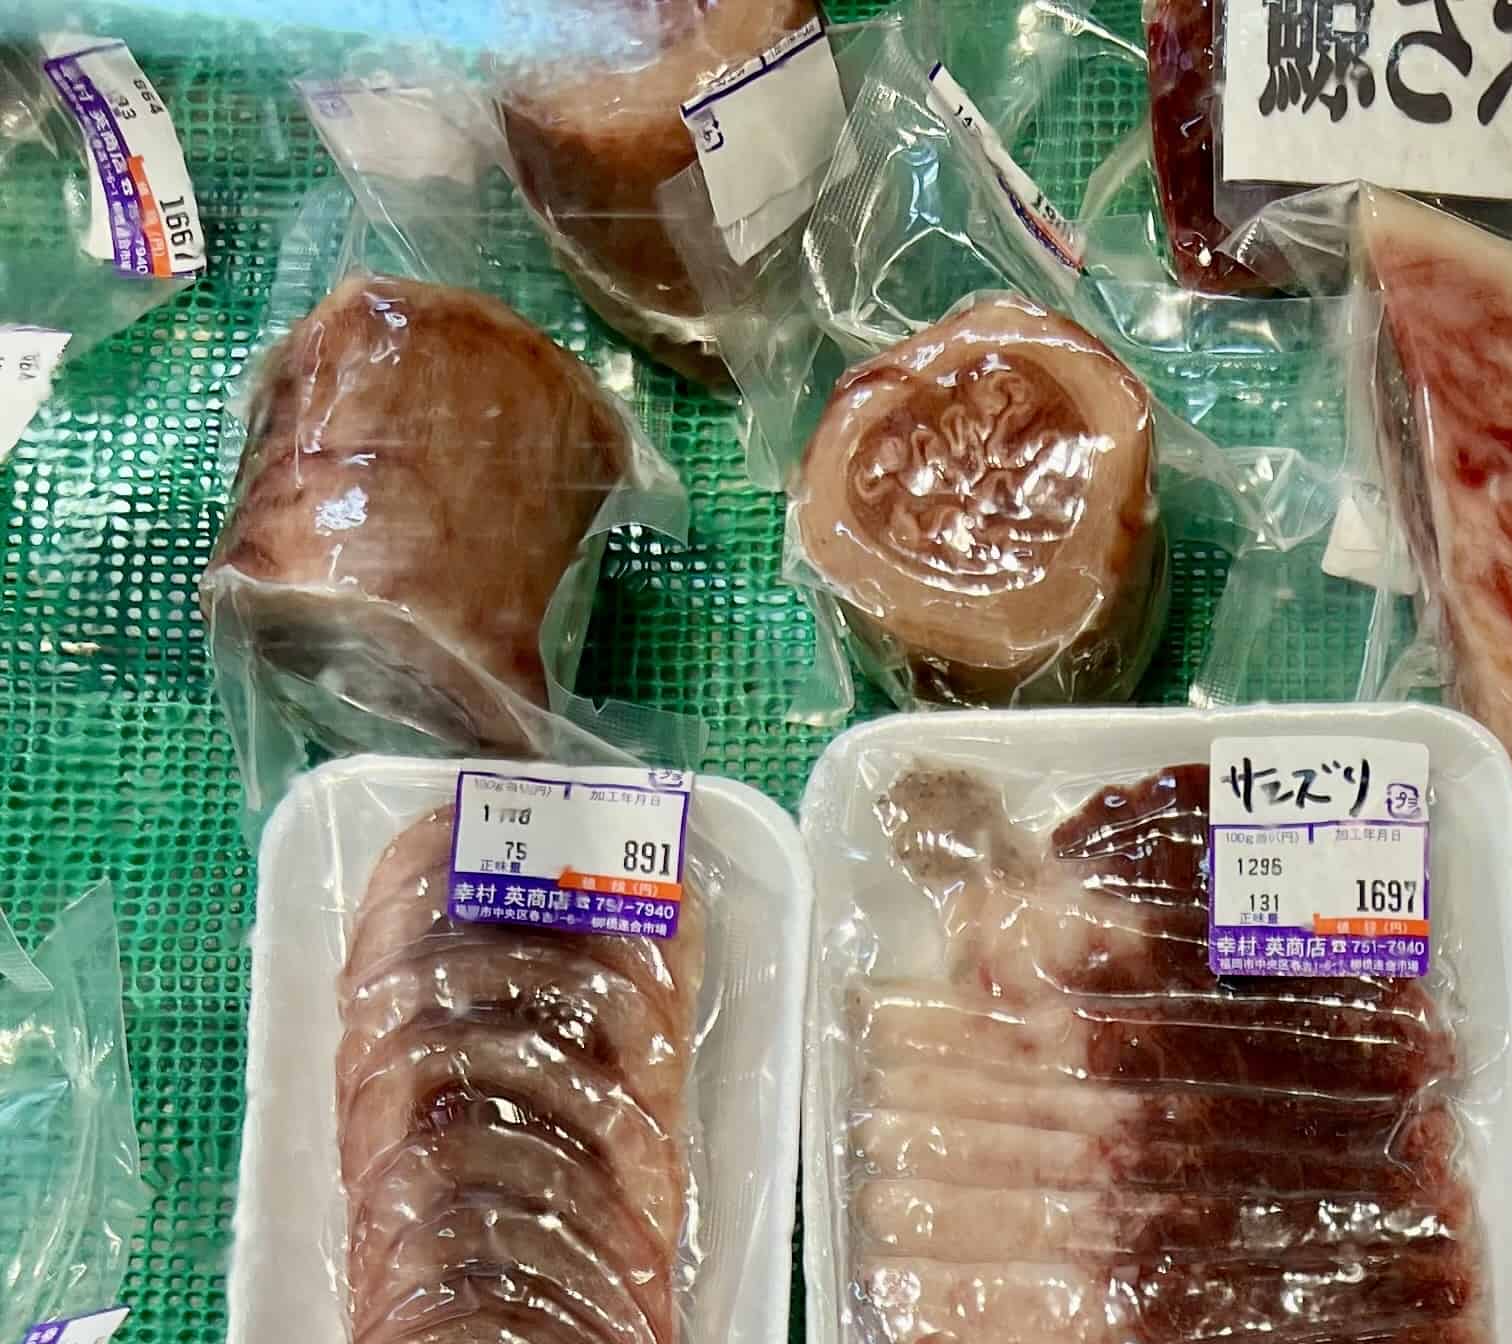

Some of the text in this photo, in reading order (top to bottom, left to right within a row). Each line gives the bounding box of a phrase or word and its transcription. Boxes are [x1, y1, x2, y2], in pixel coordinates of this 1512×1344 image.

[505, 841, 527, 860] 75
[624, 840, 671, 876] 891
[1237, 858, 1283, 876] 1296
[455, 882, 496, 904] 幸村
[504, 885, 569, 911] 英商店
[1250, 894, 1280, 913] 131
[1356, 879, 1417, 913] 1697
[1216, 935, 1257, 957] 幸村
[1266, 935, 1326, 957] 英商店
